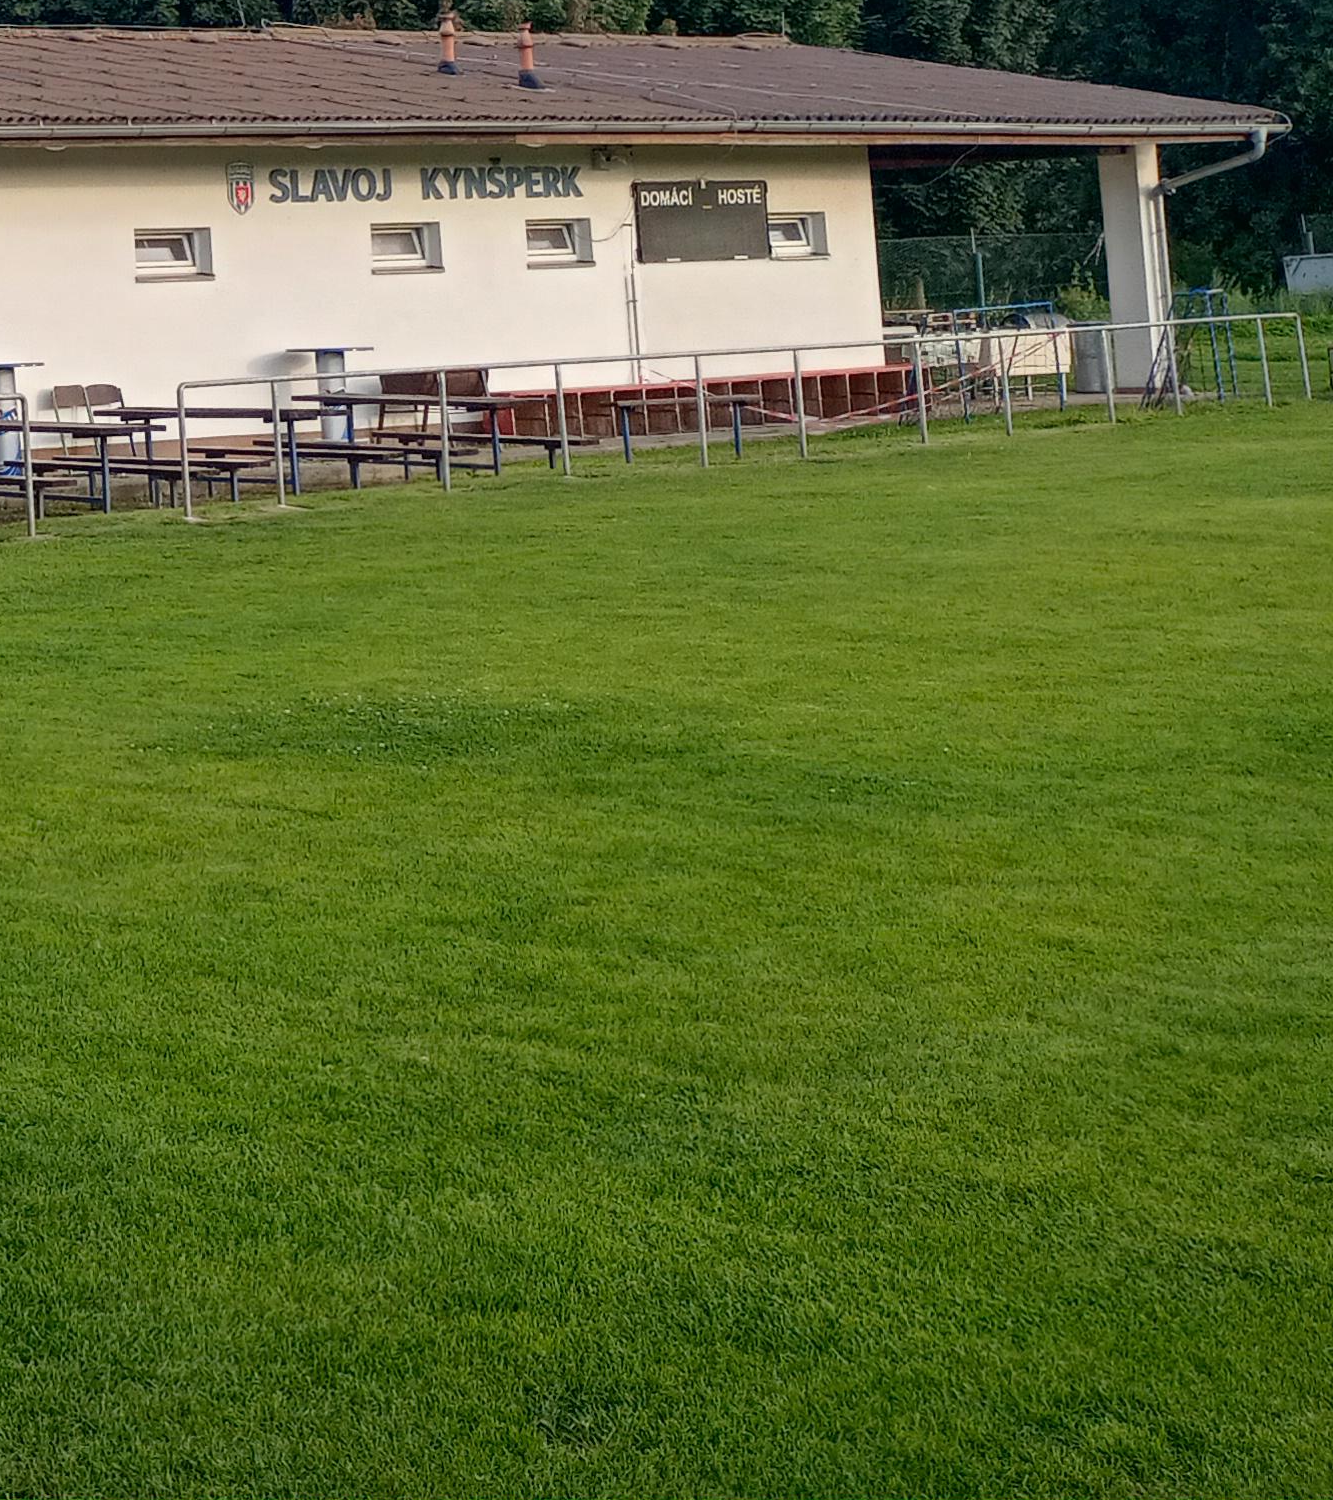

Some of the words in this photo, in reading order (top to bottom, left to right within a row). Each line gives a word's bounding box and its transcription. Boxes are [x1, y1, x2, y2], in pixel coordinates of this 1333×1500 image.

[268, 167, 393, 203] SLAVOJ
[420, 157, 584, 200] KYNŠPERK
[640, 186, 693, 207] DOMÁCÍ
[718, 185, 762, 205] HOSTÉ
